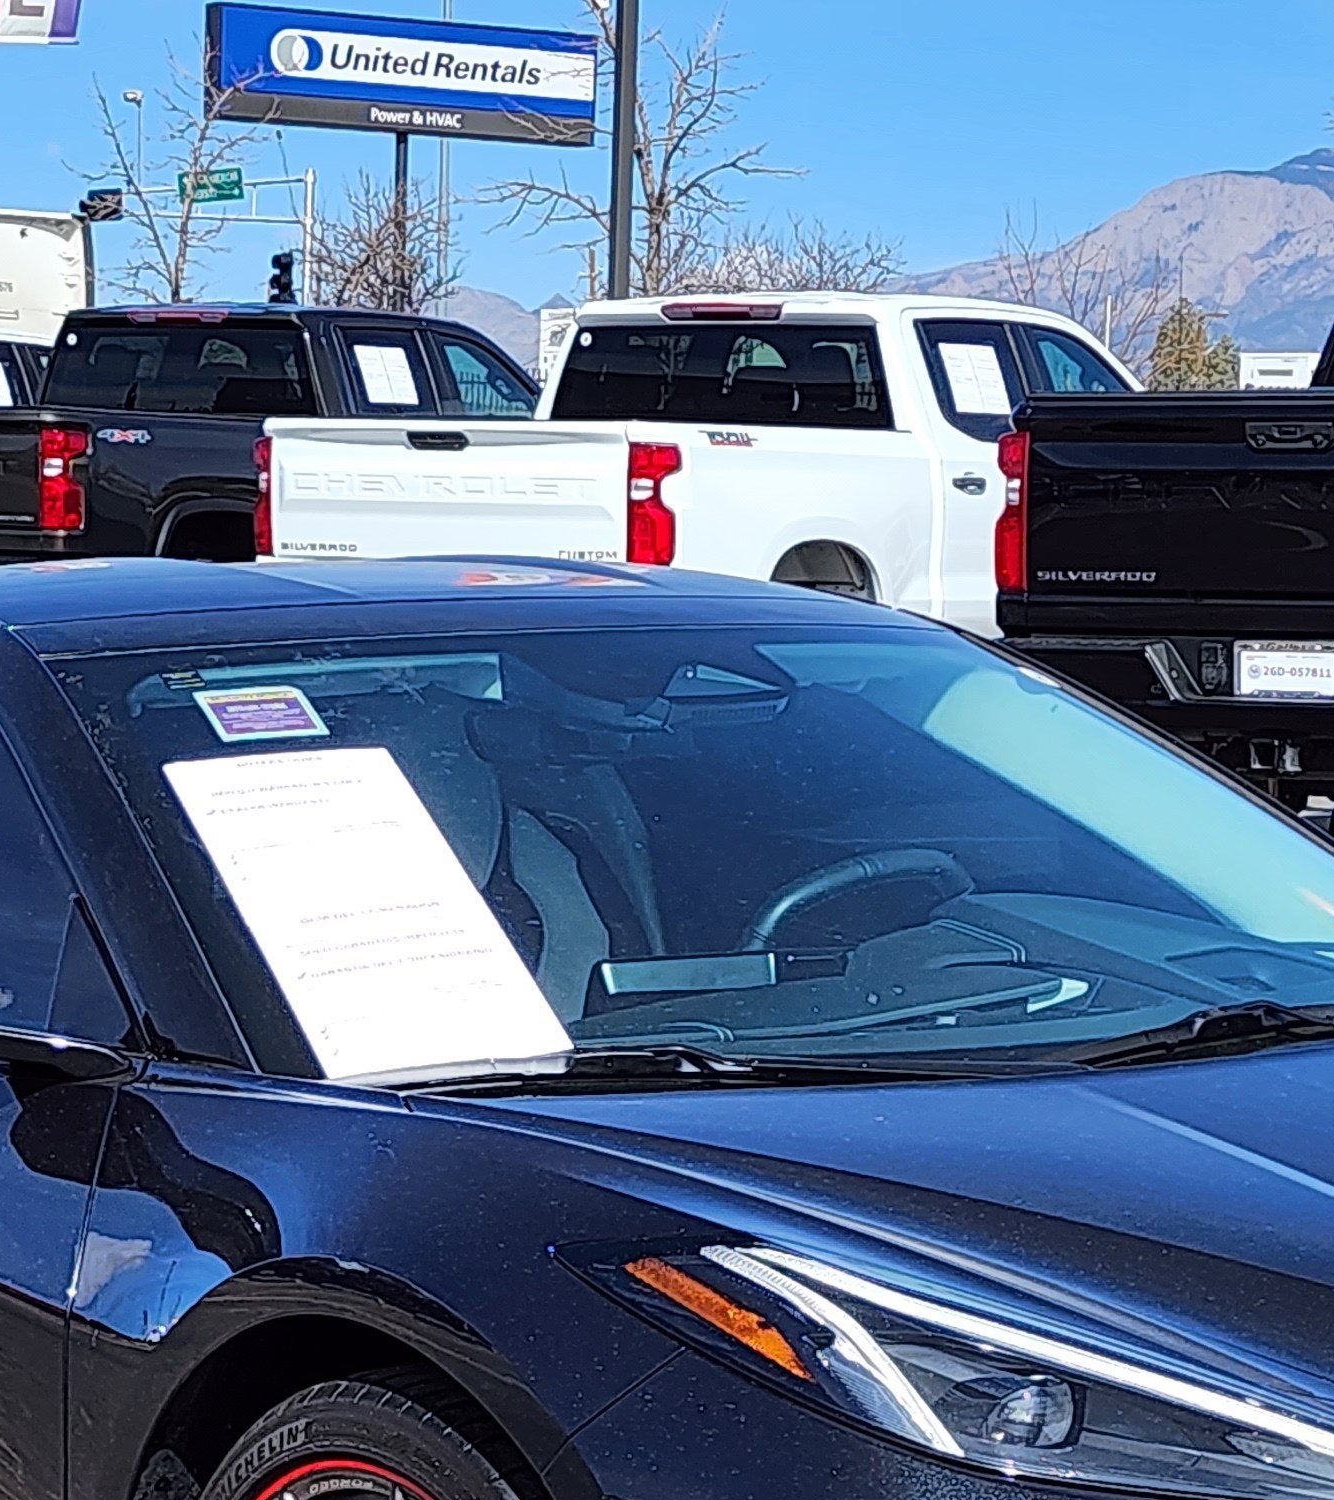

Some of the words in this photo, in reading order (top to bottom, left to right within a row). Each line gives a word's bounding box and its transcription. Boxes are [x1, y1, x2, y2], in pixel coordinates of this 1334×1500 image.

[330, 43, 430, 76] United
[435, 53, 541, 85] Rentals
[370, 107, 411, 124] Power
[412, 110, 424, 125] &
[426, 111, 462, 129] HVAC
[291, 471, 598, 498] CHEVROLET
[279, 541, 359, 553] SILVERADO
[1036, 569, 1158, 583] SILVERADO
